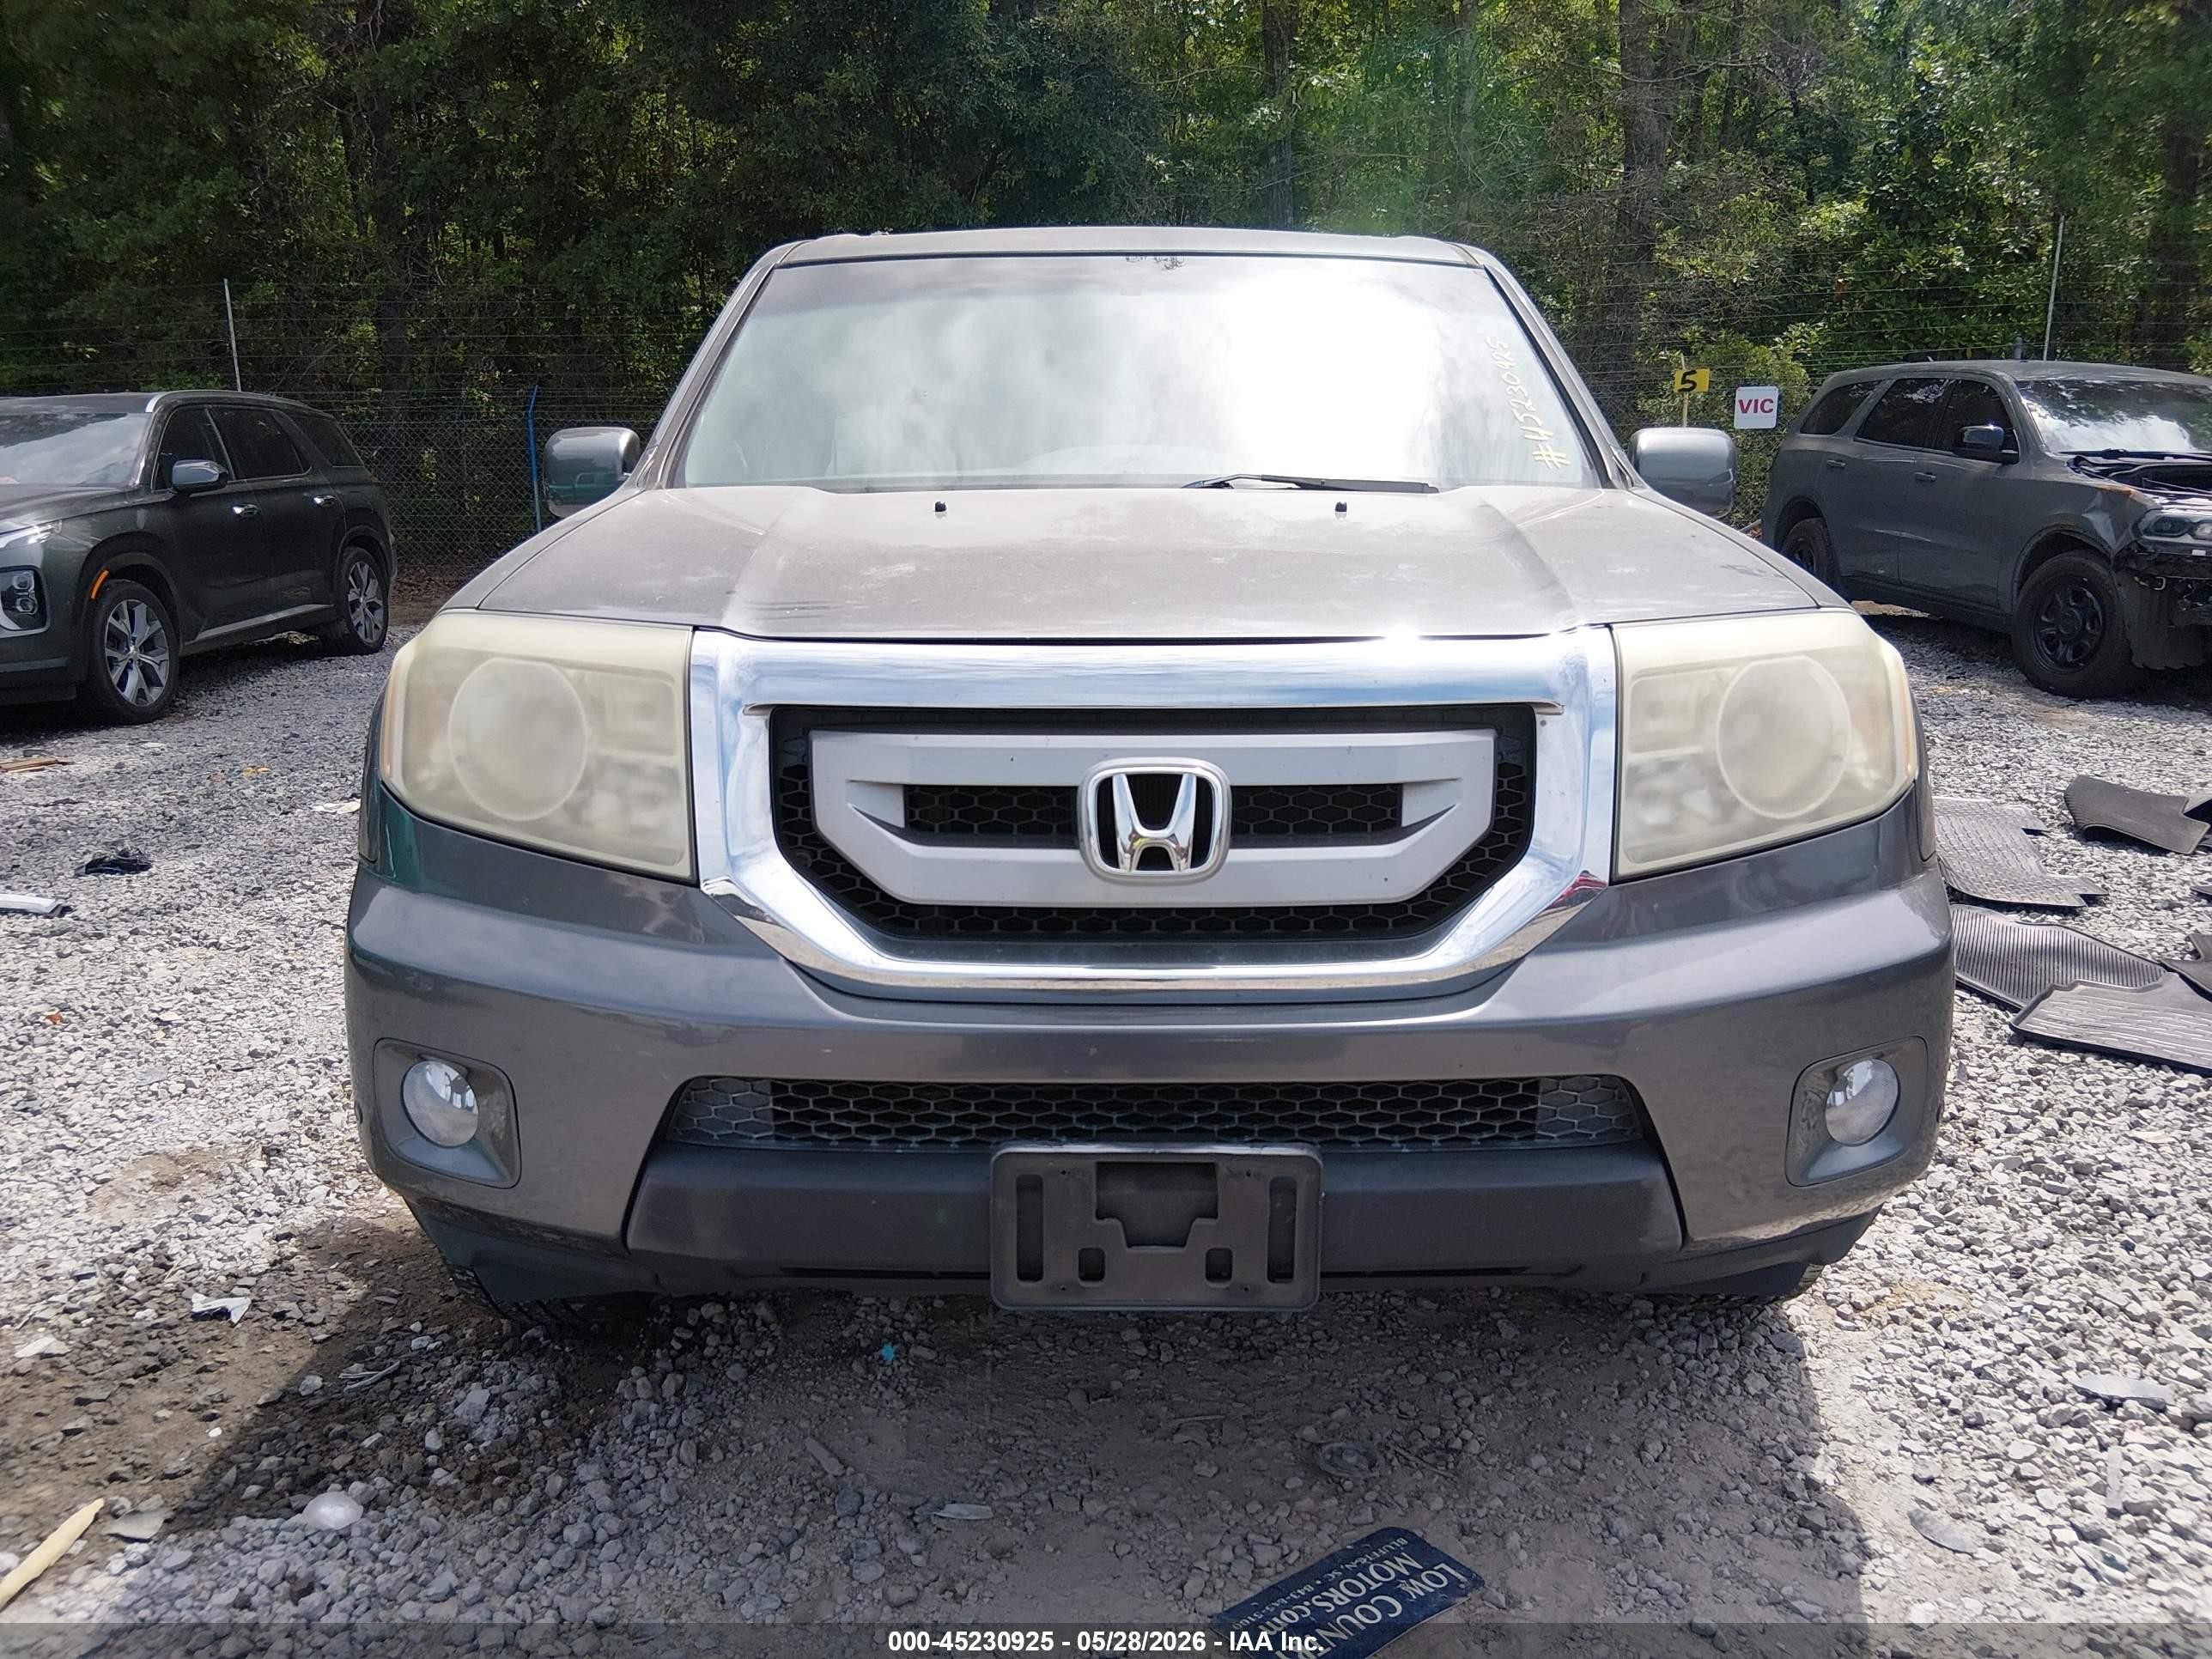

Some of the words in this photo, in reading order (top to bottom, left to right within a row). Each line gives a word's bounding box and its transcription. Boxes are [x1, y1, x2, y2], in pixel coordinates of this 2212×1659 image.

[1678, 369, 1698, 392] 5
[1486, 335, 1571, 470] #45230925
[1738, 398, 1774, 414] VIC
